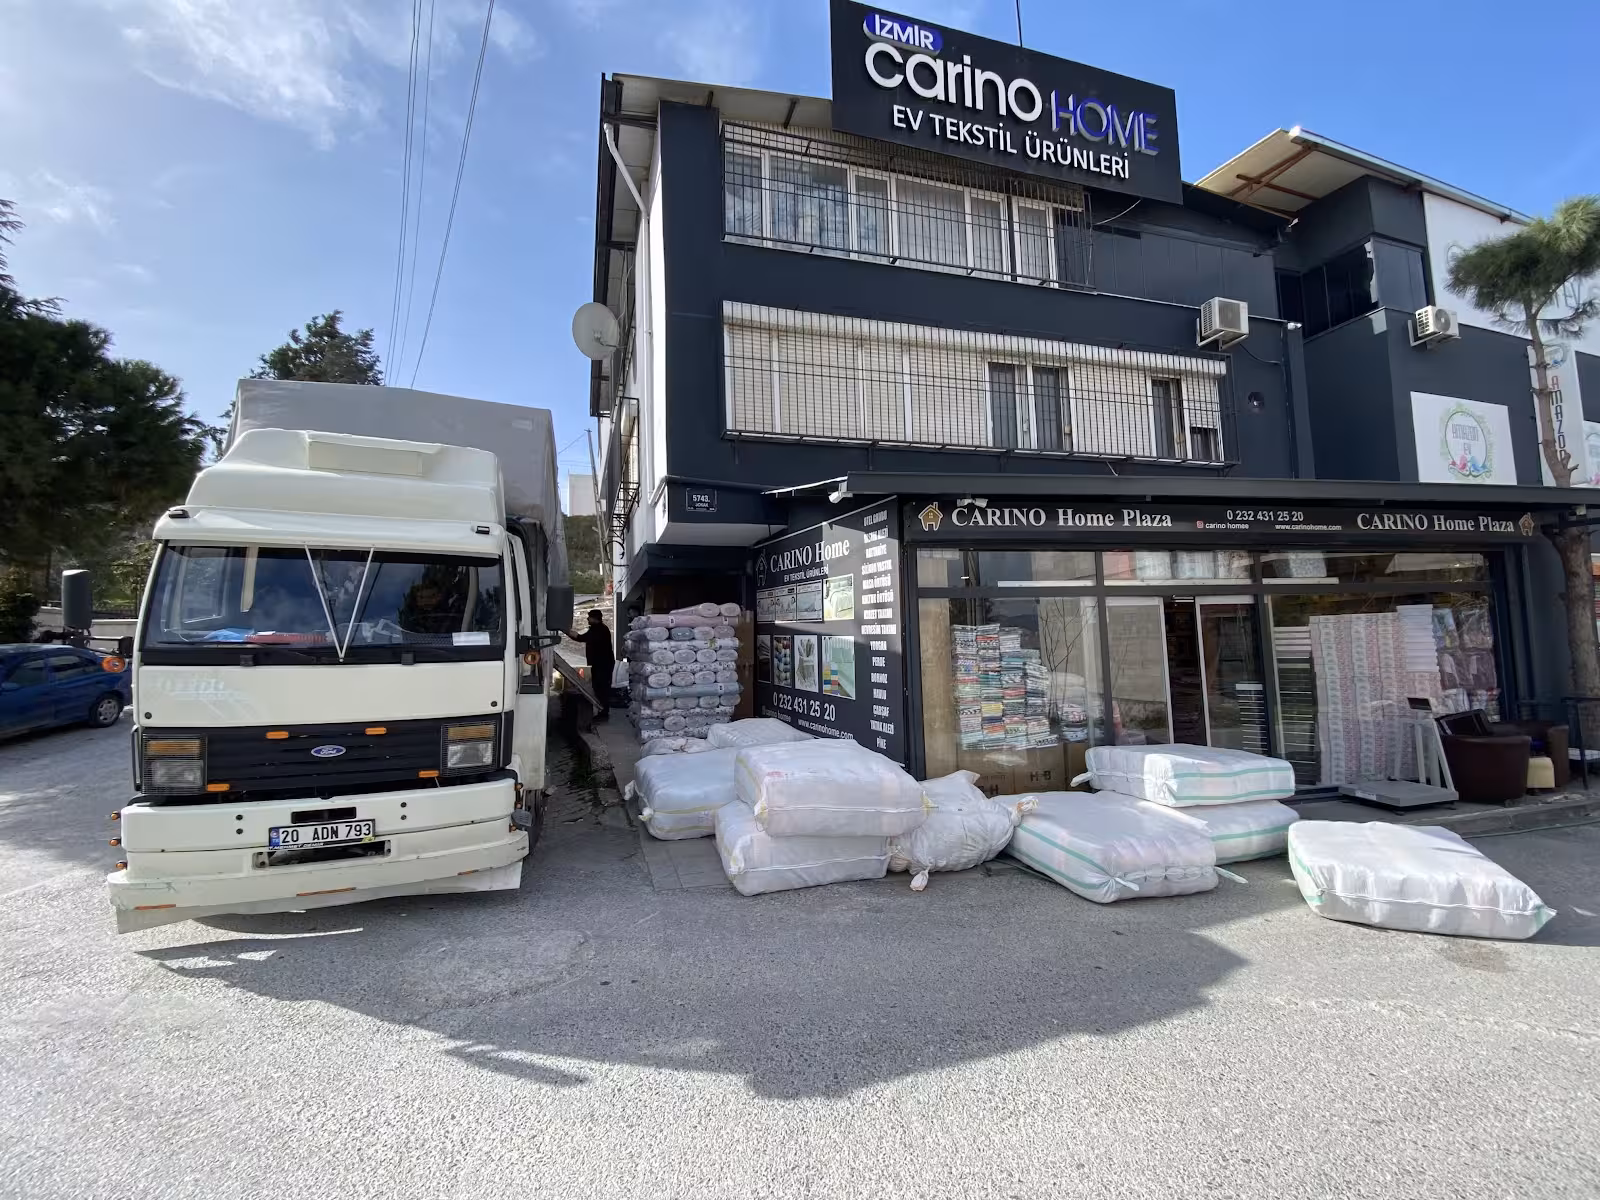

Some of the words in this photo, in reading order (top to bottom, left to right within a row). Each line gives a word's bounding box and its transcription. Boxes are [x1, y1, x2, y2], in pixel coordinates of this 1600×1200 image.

[864, 42, 1043, 122] carino
[1050, 89, 1159, 156] HOME
[893, 104, 924, 131] EV
[929, 113, 1018, 154] TEKSTİL
[1025, 130, 1130, 180] ÜRÜNLERİ
[951, 507, 1047, 527] CARINO
[1057, 508, 1115, 527] Home
[1121, 508, 1173, 528] Plaza
[1226, 509, 1233, 520] 0
[1236, 510, 1255, 521] 232
[1256, 510, 1274, 521] 431
[1277, 511, 1290, 522] 25
[1291, 511, 1304, 522] 20
[1356, 511, 1428, 531] CARINO
[1433, 513, 1475, 532] Home
[1478, 515, 1515, 533] Plaza
[1275, 523, 1342, 531] www.carinohome.com
[770, 545, 812, 573] CARINO
[815, 539, 850, 563] Home
[872, 656, 885, 666] PERDE
[773, 691, 778, 707] 0
[778, 693, 792, 711] 232
[793, 696, 807, 715] 431
[809, 699, 820, 718] 25
[823, 702, 836, 722] 20
[281, 829, 299, 844] 20
[312, 825, 339, 841] ADN
[345, 823, 372, 839] 793
